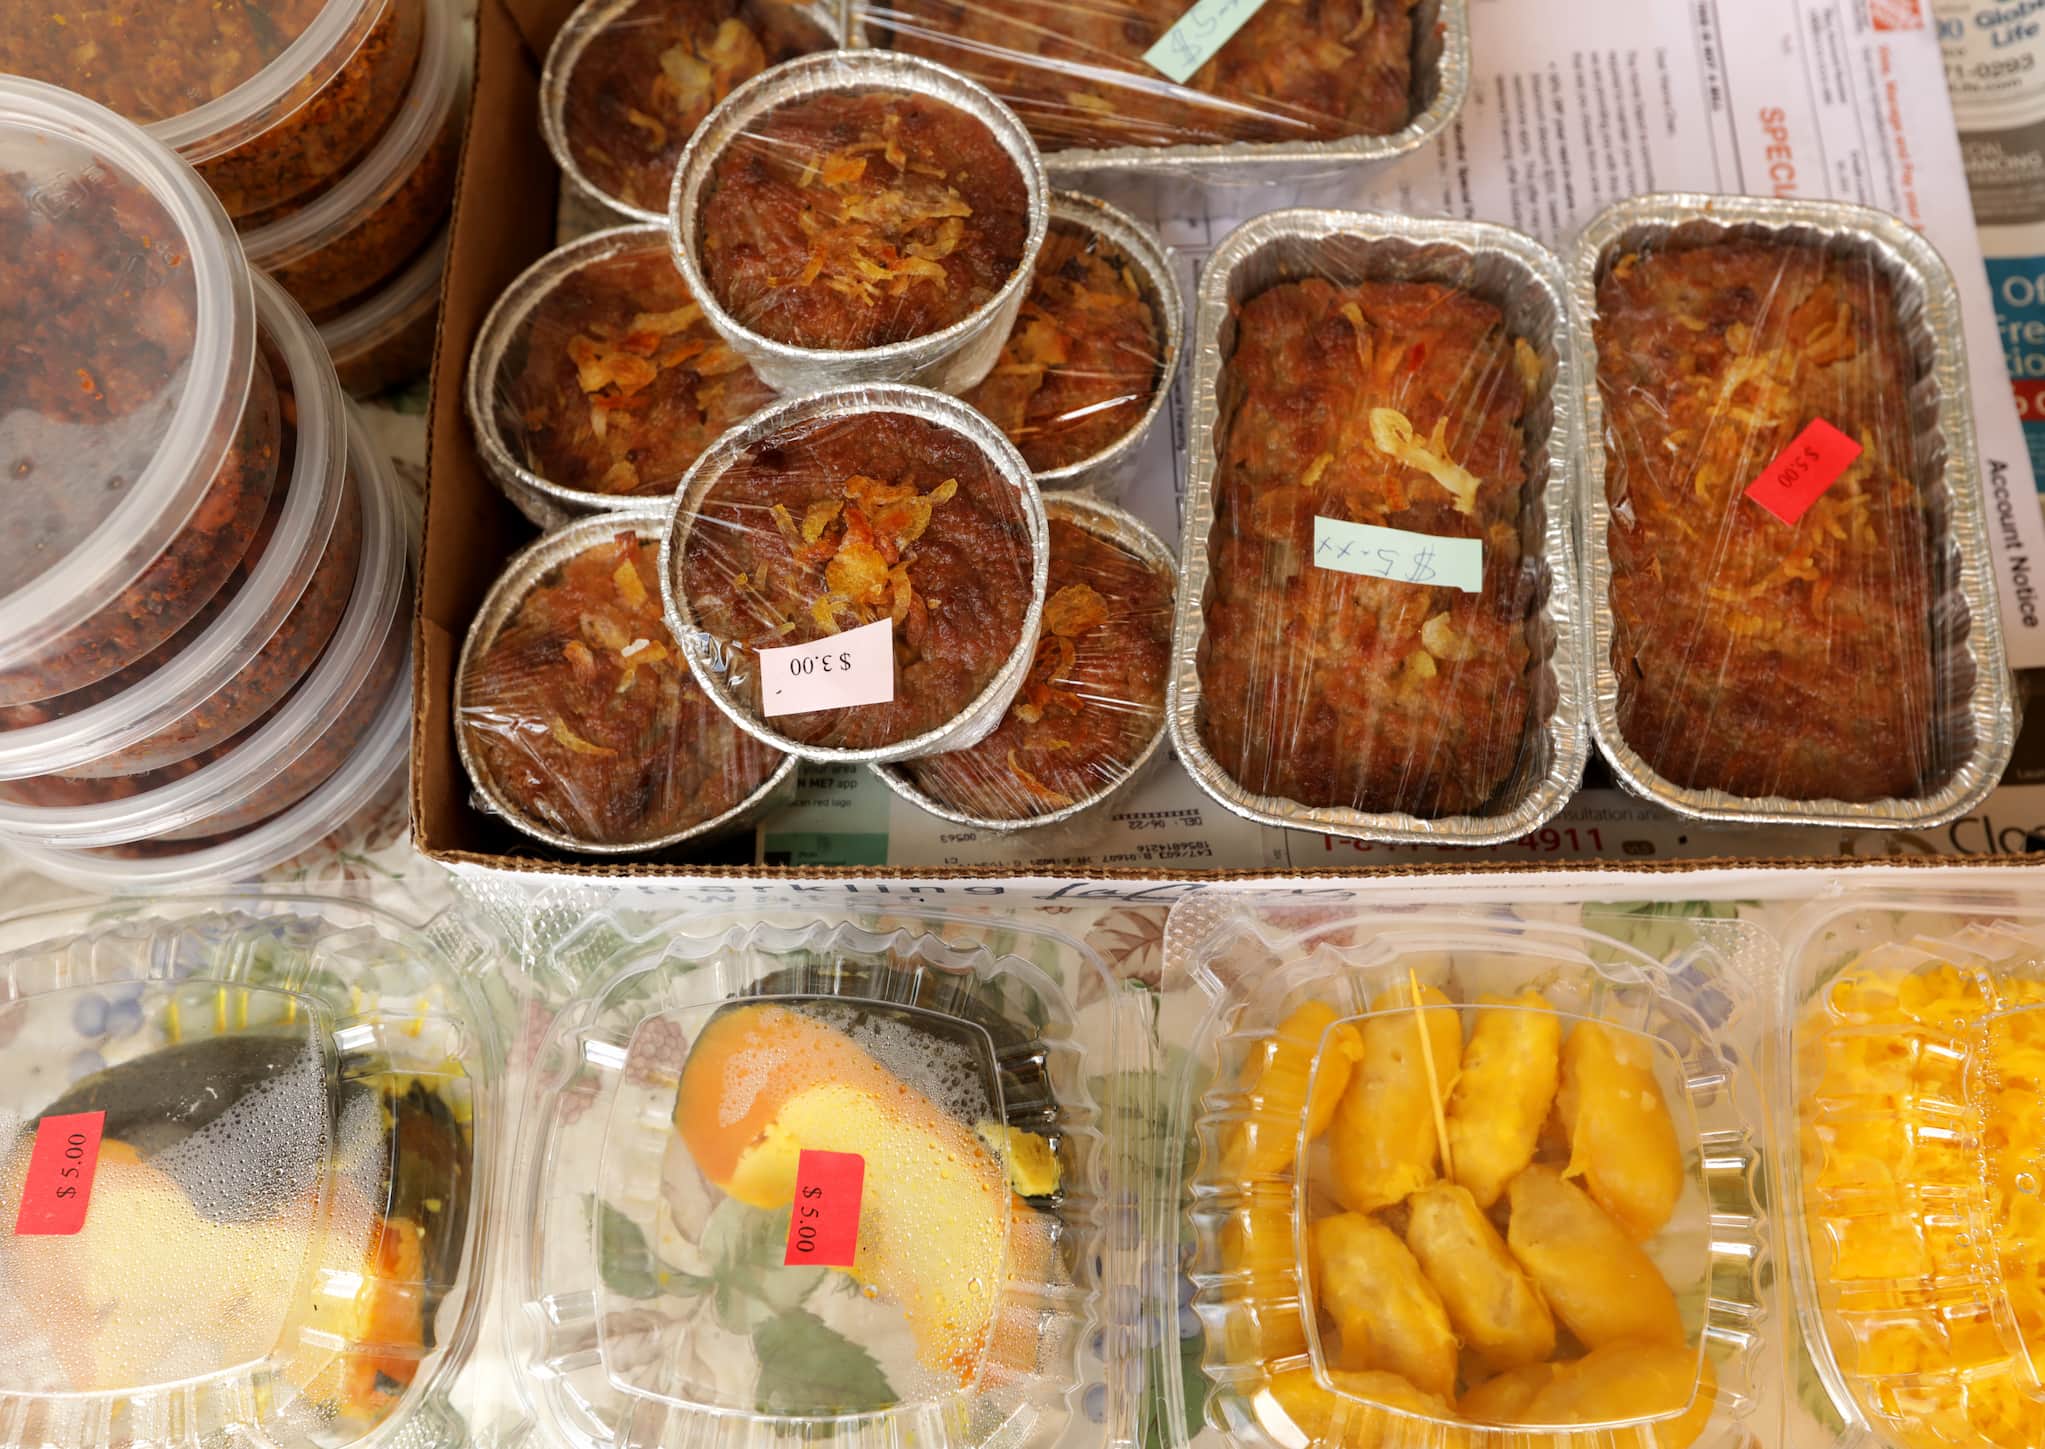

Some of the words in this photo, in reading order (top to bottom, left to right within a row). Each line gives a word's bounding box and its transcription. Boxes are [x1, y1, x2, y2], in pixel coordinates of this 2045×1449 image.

[1991, 22, 2040, 47] Life
[1777, 455, 1809, 489] 5.00
[1988, 459, 2023, 549] Account
[2008, 556, 2039, 628] Notice
[790, 654, 833, 676] 3.00
[61, 1134, 87, 1178] 5.00
[796, 1206, 819, 1253] 5.00
